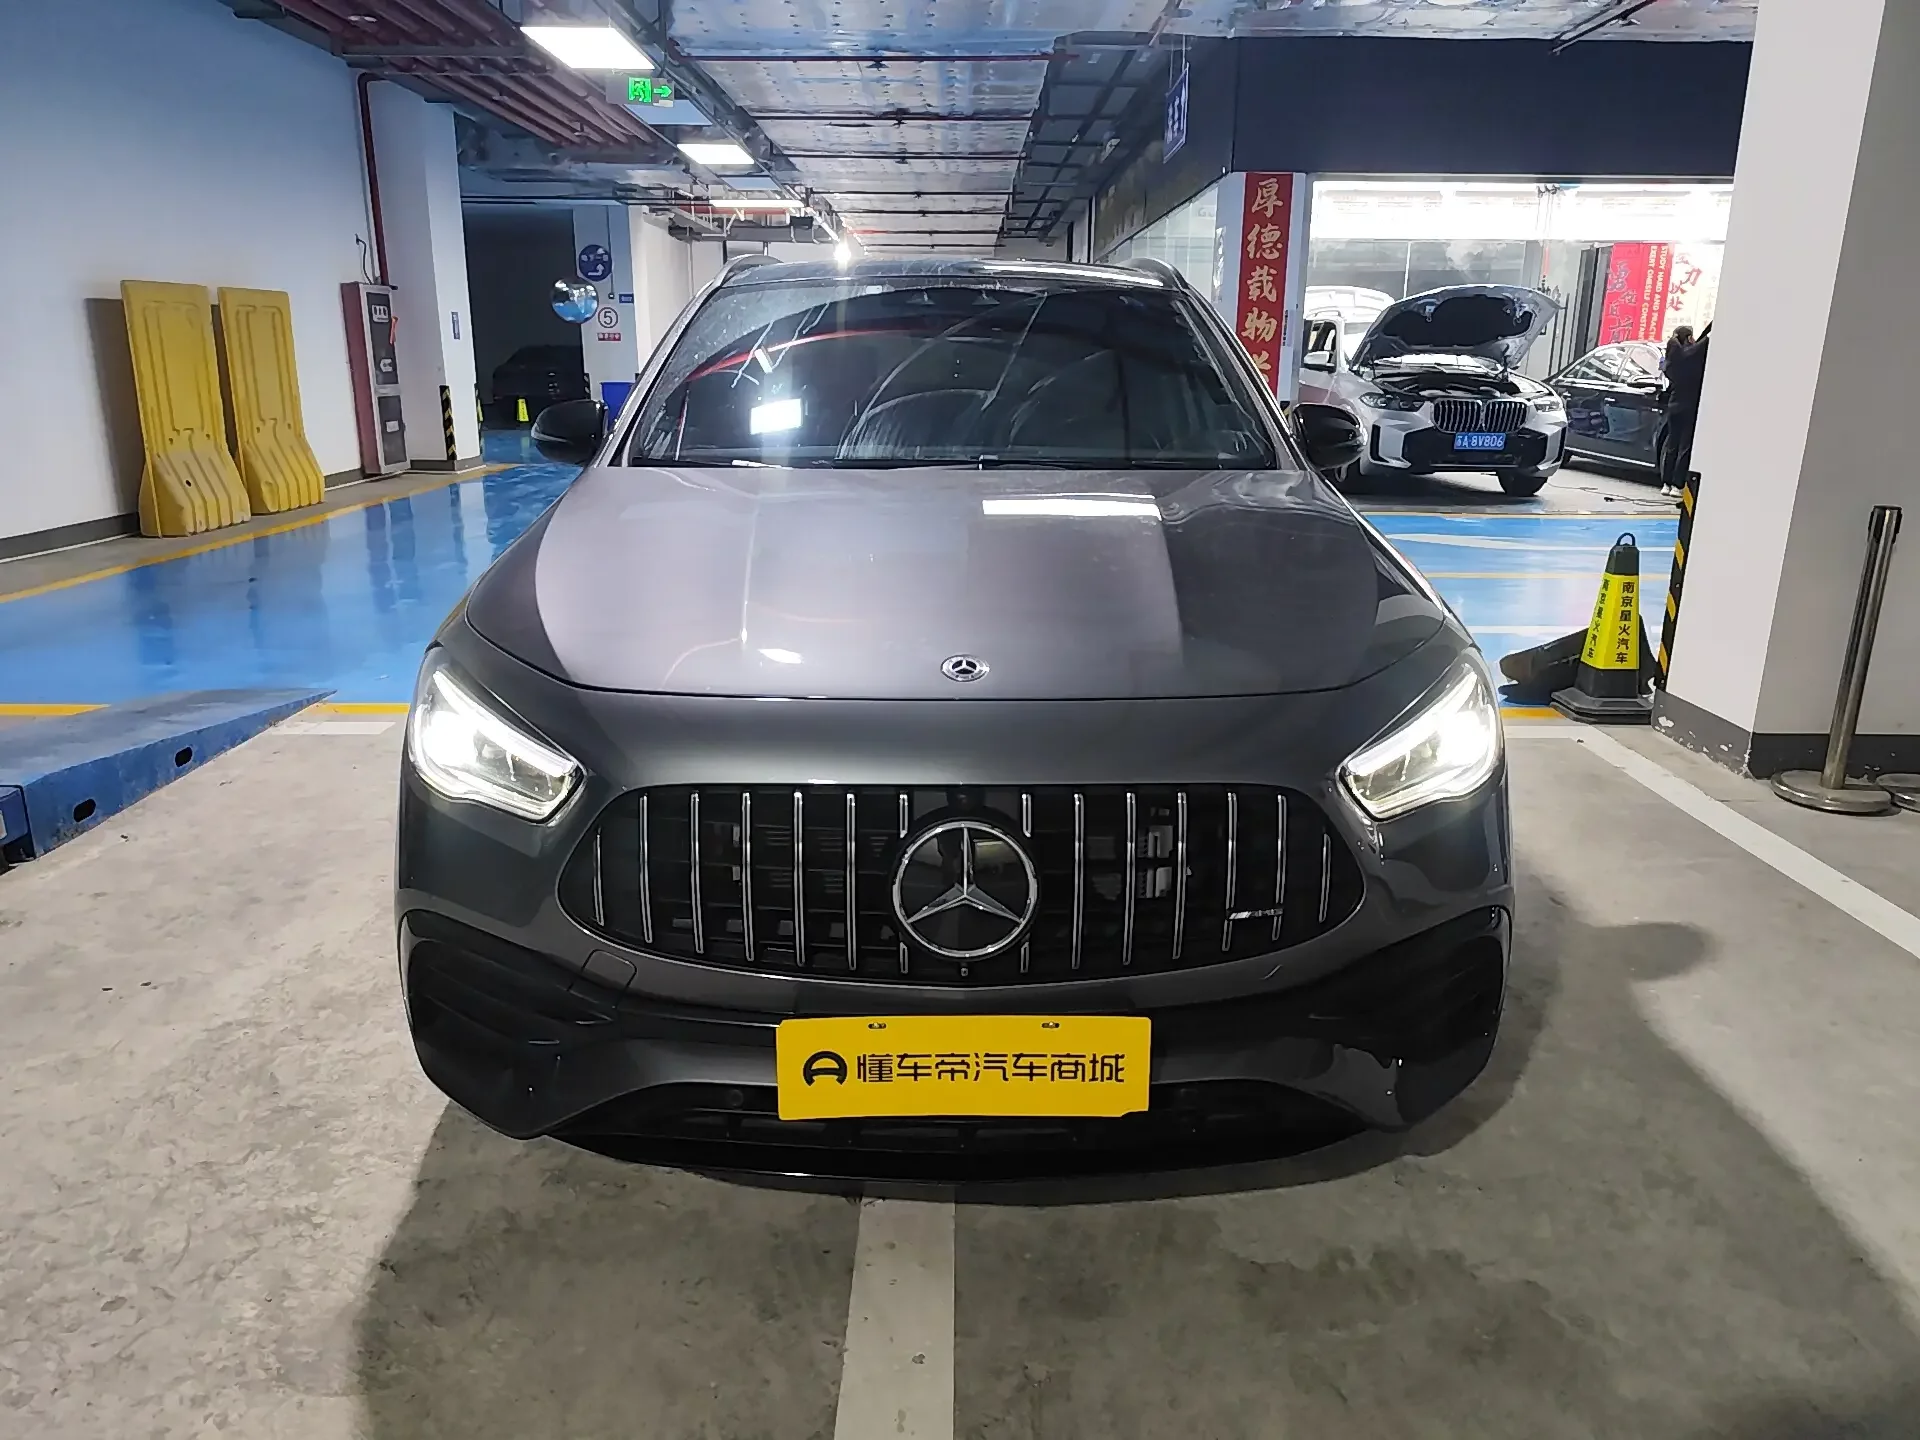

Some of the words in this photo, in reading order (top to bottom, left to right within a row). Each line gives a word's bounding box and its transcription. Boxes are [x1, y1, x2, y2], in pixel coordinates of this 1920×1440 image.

[1648, 245, 1658, 267] EXERT
[1659, 245, 1668, 269] STUDY
[1656, 271, 1664, 292] HARD
[1653, 292, 1661, 311] AND
[1615, 581, 1636, 665] 南京星火汽车
[856, 1052, 1126, 1084] 懂车帝汽车商城
